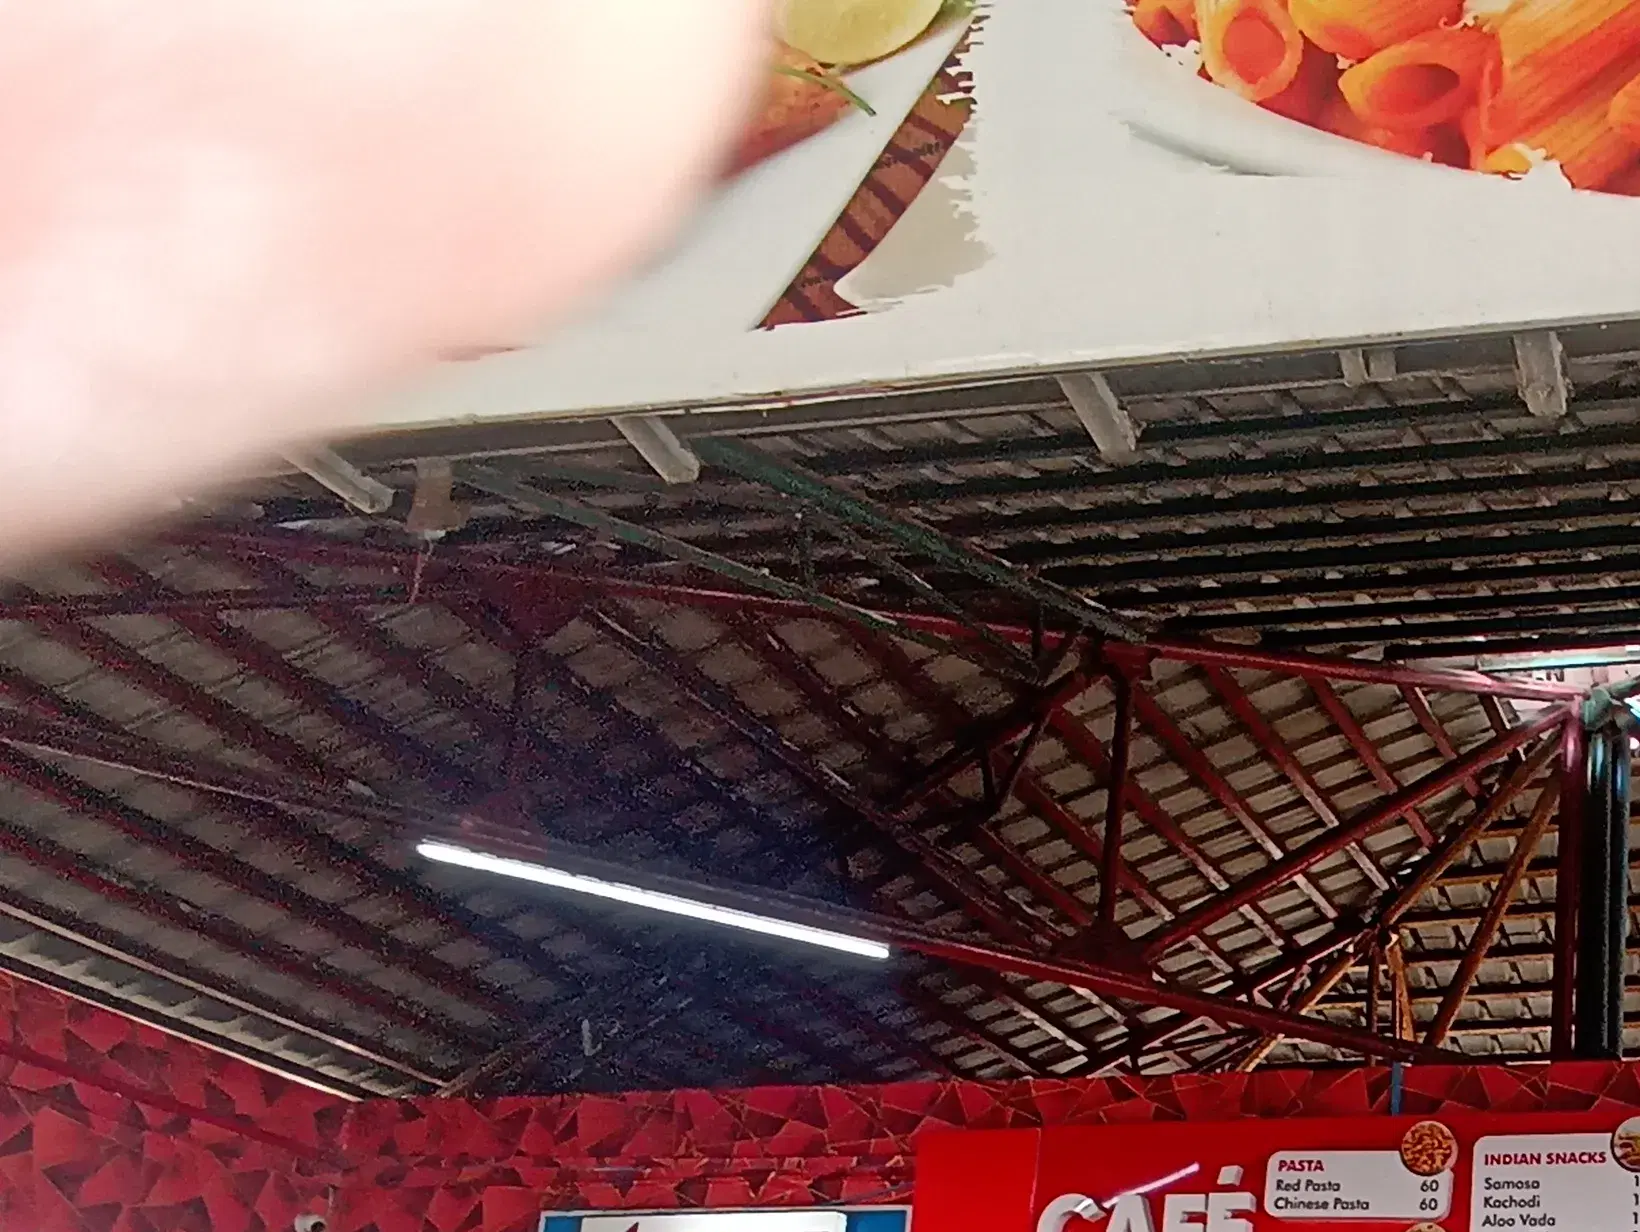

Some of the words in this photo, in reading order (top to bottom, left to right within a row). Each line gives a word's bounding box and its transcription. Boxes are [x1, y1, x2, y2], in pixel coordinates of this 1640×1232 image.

[1484, 1152, 1542, 1166] INDIAN
[1546, 1151, 1607, 1165] SNACKS
[1278, 1160, 1324, 1172] PASTA
[1276, 1178, 1301, 1192] Red
[1304, 1179, 1341, 1192] Pasta
[1420, 1179, 1439, 1192] 60
[1484, 1177, 1540, 1190] Samosa
[1274, 1196, 1329, 1210] Chinese
[1333, 1197, 1369, 1210] Pasta
[1419, 1198, 1438, 1211] 60
[1483, 1195, 1540, 1209] Kachodi
[1481, 1214, 1516, 1227] Aloo
[1519, 1213, 1556, 1227] Vada
